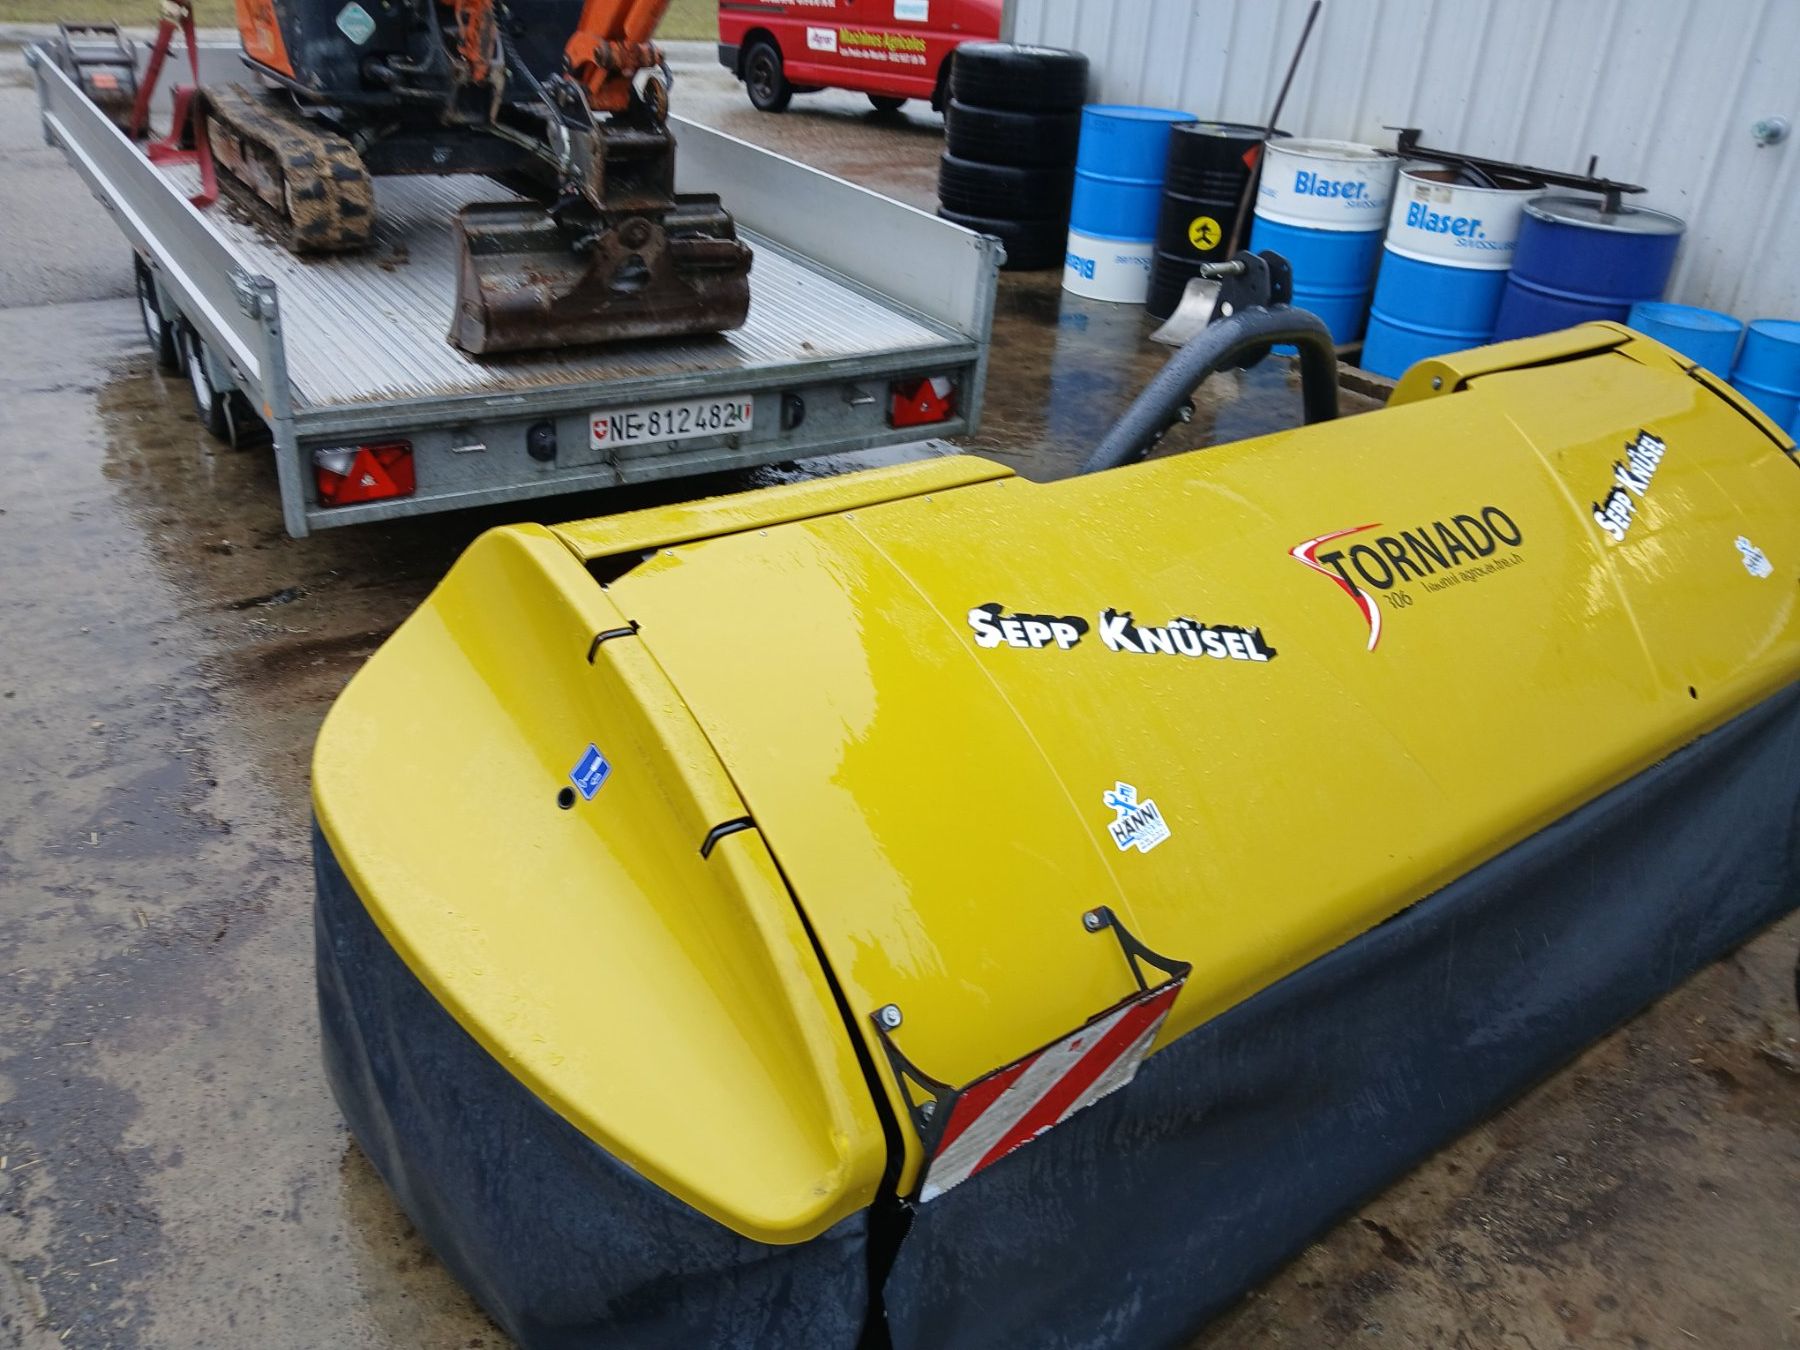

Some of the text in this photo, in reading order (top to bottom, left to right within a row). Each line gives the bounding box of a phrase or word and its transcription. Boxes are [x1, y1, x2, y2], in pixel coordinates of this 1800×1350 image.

[1317, 506, 1523, 598] TORNADO
[967, 603, 1278, 662] SEPP KNÜSEL
